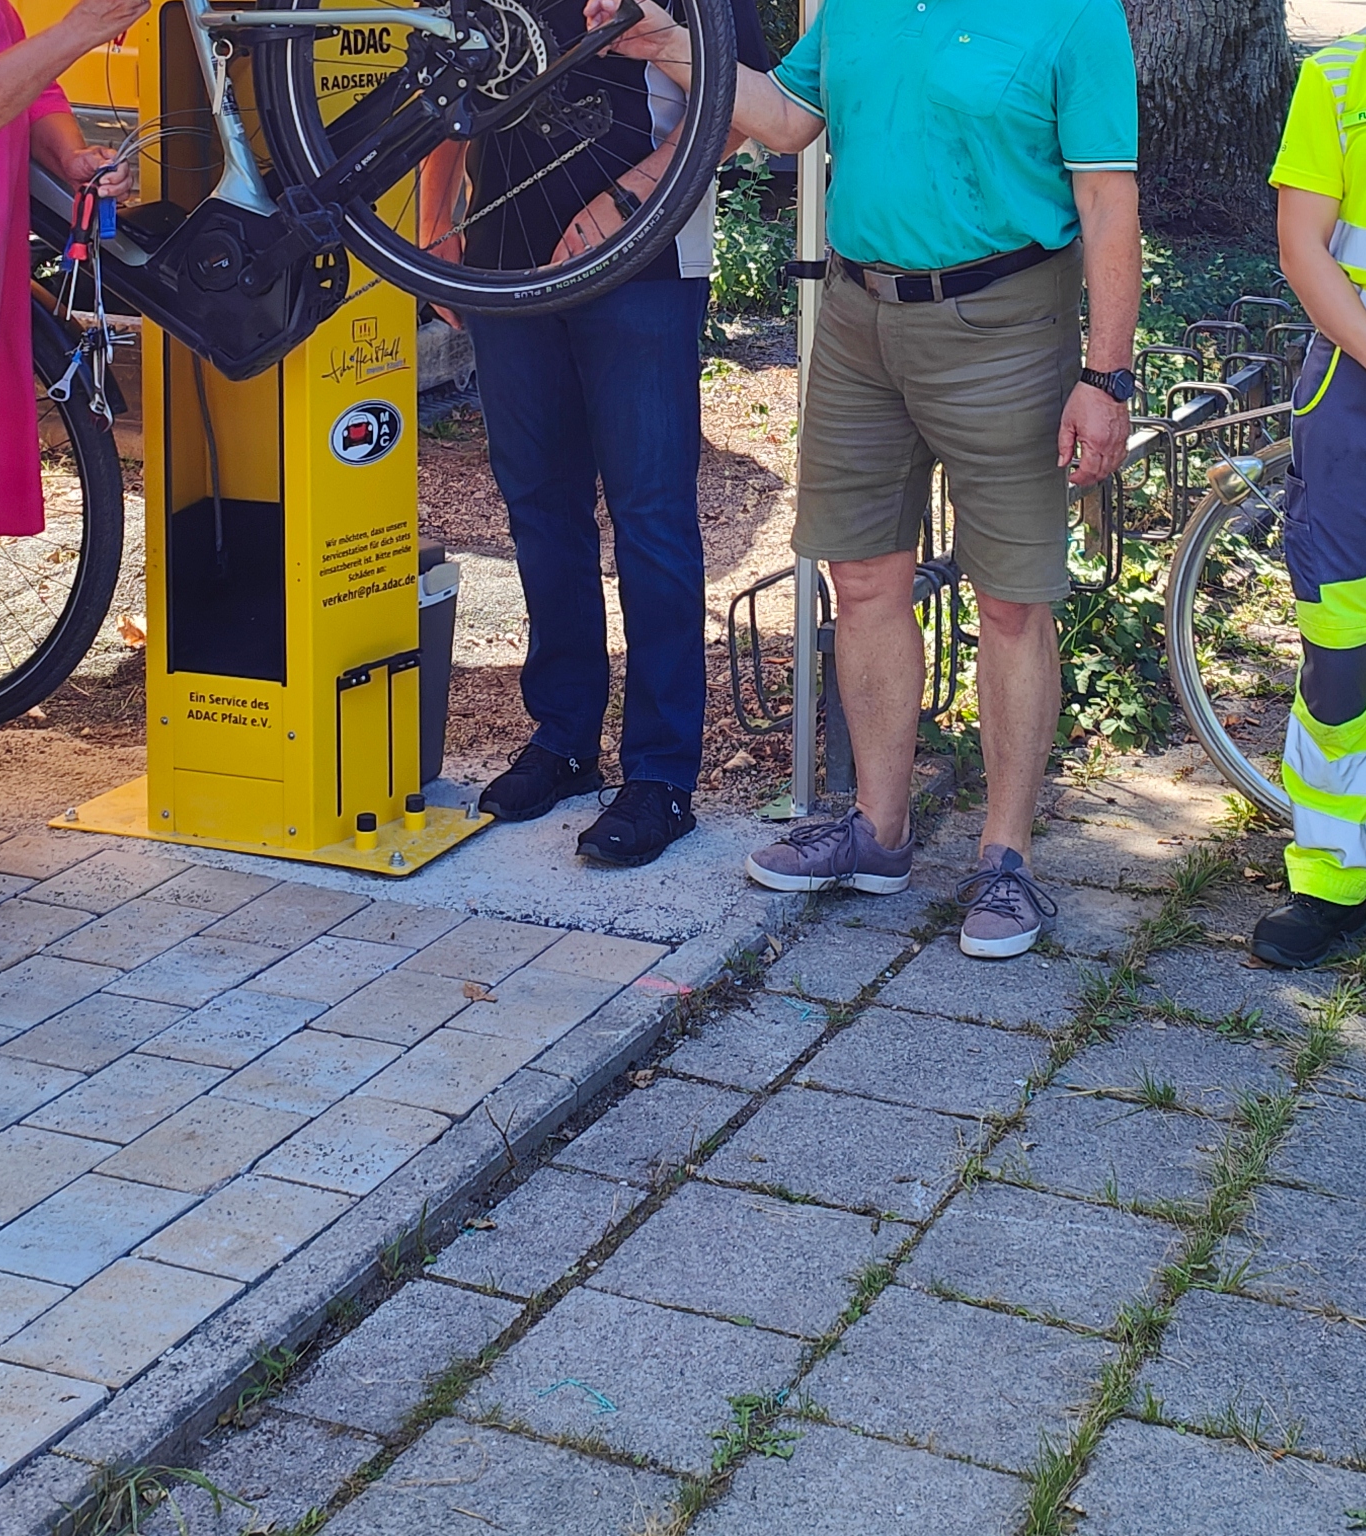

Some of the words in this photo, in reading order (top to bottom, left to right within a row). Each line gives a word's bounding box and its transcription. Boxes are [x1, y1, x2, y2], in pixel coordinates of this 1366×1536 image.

[339, 27, 391, 56] ADAC
[514, 290, 542, 299] PLUS
[322, 544, 368, 563] Servicestation
[369, 541, 379, 550] für
[380, 537, 395, 547] dich
[395, 532, 411, 543] stets
[325, 537, 337, 548] Wir
[370, 527, 385, 537] dass
[386, 521, 408, 532] unsere
[319, 558, 362, 577] einsatzbereit
[375, 551, 391, 561] Bitte
[392, 544, 412, 556] melde
[322, 573, 416, 608] verkehr@pfa.adac.de
[189, 691, 205, 703] Ein
[208, 693, 247, 708] Service
[250, 698, 269, 710] des
[187, 709, 218, 722] ADAC
[221, 712, 247, 726] Pfalz
[250, 717, 272, 728] e.V.
